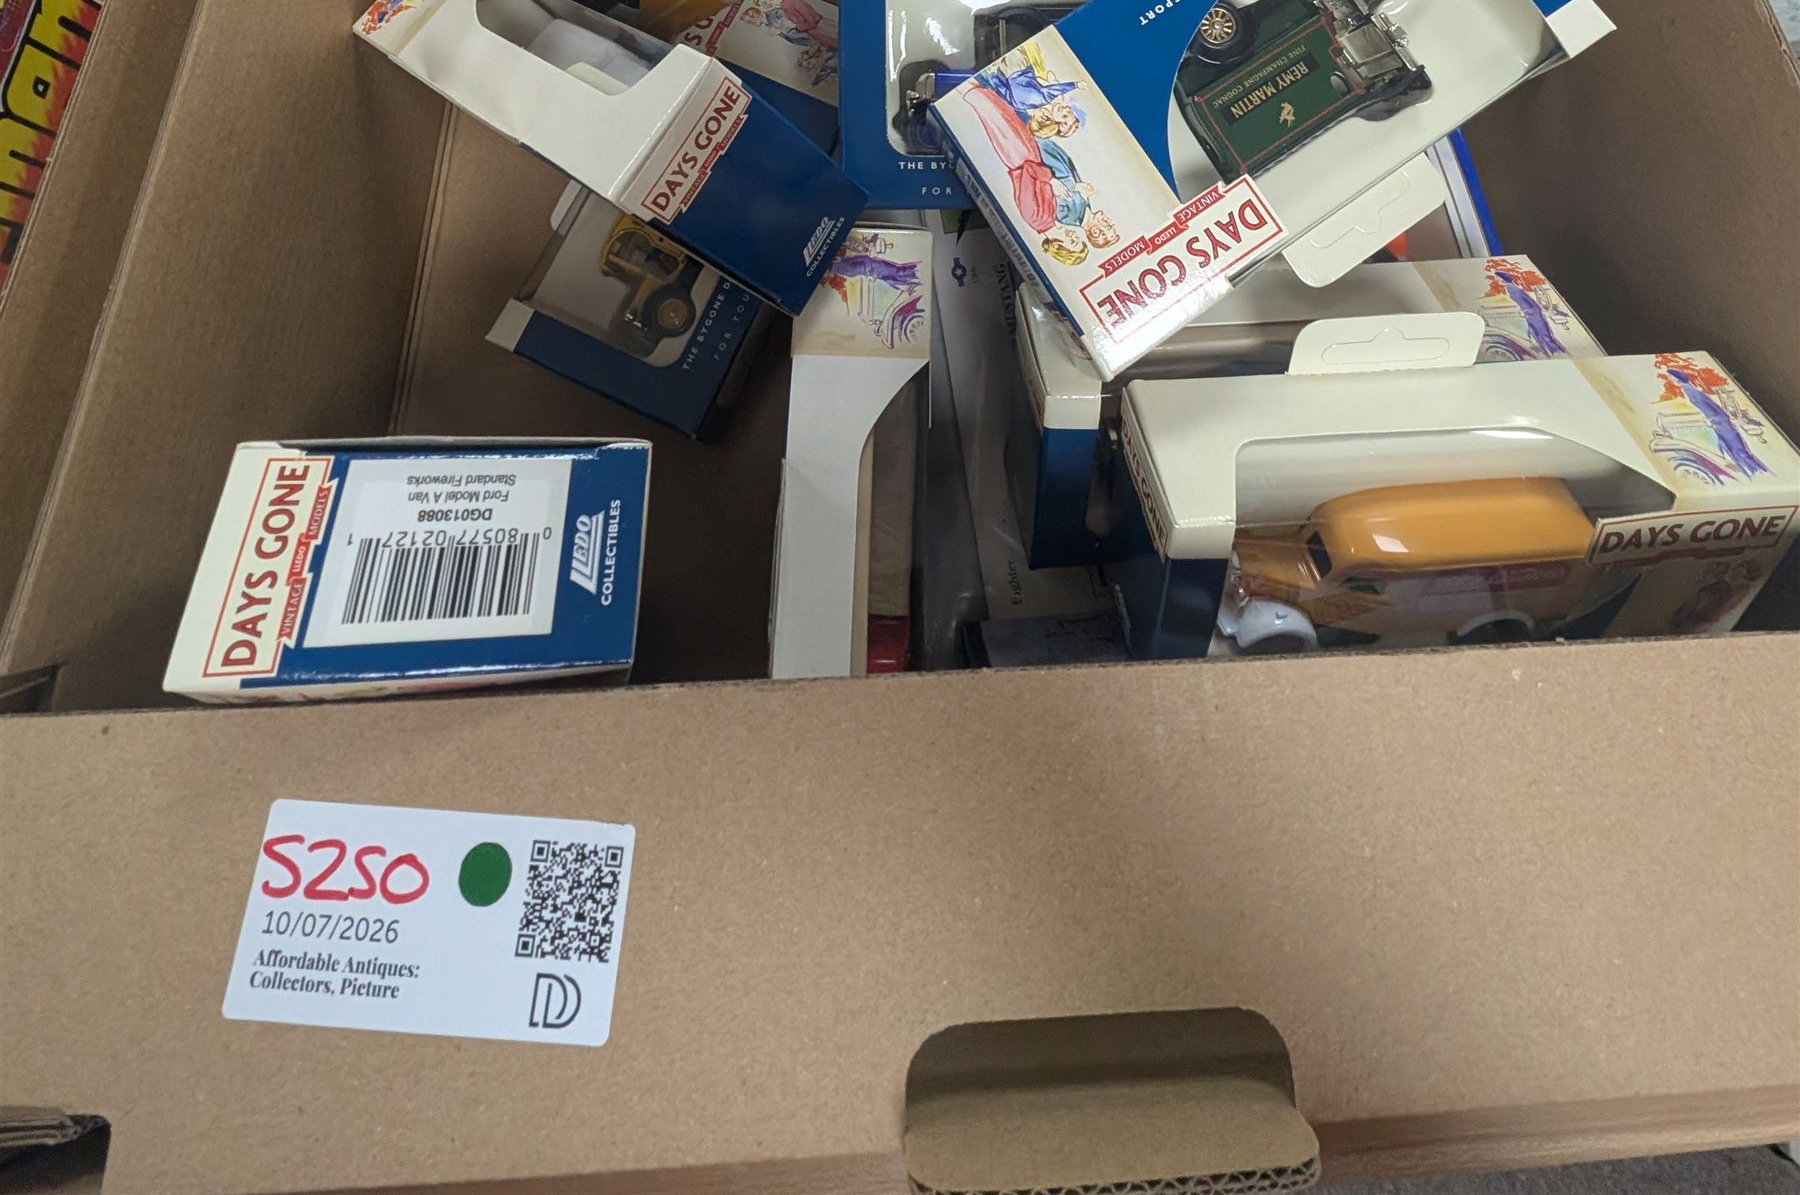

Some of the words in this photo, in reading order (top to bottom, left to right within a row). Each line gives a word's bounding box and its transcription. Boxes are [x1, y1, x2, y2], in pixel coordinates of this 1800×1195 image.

[1287, 44, 1306, 59] FINE
[1242, 55, 1287, 87] CHAMPAGNE
[1212, 84, 1243, 108] COGNAC
[1229, 81, 1276, 118] MARTIN
[650, 149, 699, 213] DAYS
[694, 85, 742, 152] GONE
[899, 160, 925, 171] THE
[922, 186, 953, 195] FOR
[1176, 189, 1218, 222] VINTAGE
[802, 218, 835, 266] LLEDO
[806, 216, 845, 277] COLLECTIBLES
[1152, 225, 1177, 245] LLEDO
[1181, 196, 1269, 270] DAYS
[1102, 239, 1145, 271] MODELS
[1088, 249, 1192, 333] GONE
[694, 293, 726, 342] BYGONE
[712, 330, 733, 360] FOR
[732, 293, 752, 323] YOU
[406, 474, 461, 486] Fireworks
[465, 474, 515, 485] Standard
[482, 489, 508, 501] Ford
[1116, 421, 1146, 476] DAYS
[1133, 477, 1172, 547] GONE
[408, 492, 430, 502] Van
[432, 491, 440, 502] A
[444, 490, 479, 502] Model
[308, 489, 329, 536] MODELS
[418, 508, 492, 521] DG013088
[381, 530, 446, 546] 02127
[455, 528, 517, 543] 80577
[543, 526, 551, 538] 0
[1597, 522, 1685, 553] DAYS
[1688, 512, 1787, 545] GONE
[220, 563, 279, 666] DAYS
[253, 464, 310, 560] GONE
[291, 544, 307, 573] LLEDO
[570, 510, 605, 594] LLEDO
[601, 499, 621, 605] COLLECTIBLES
[279, 580, 304, 636] VINTAGE
[262, 909, 400, 944] 10/07/2026
[253, 949, 340, 974] Affordable
[342, 957, 420, 980] Antiques:
[249, 970, 335, 996] Collectors,
[339, 977, 400, 1000] Picture
